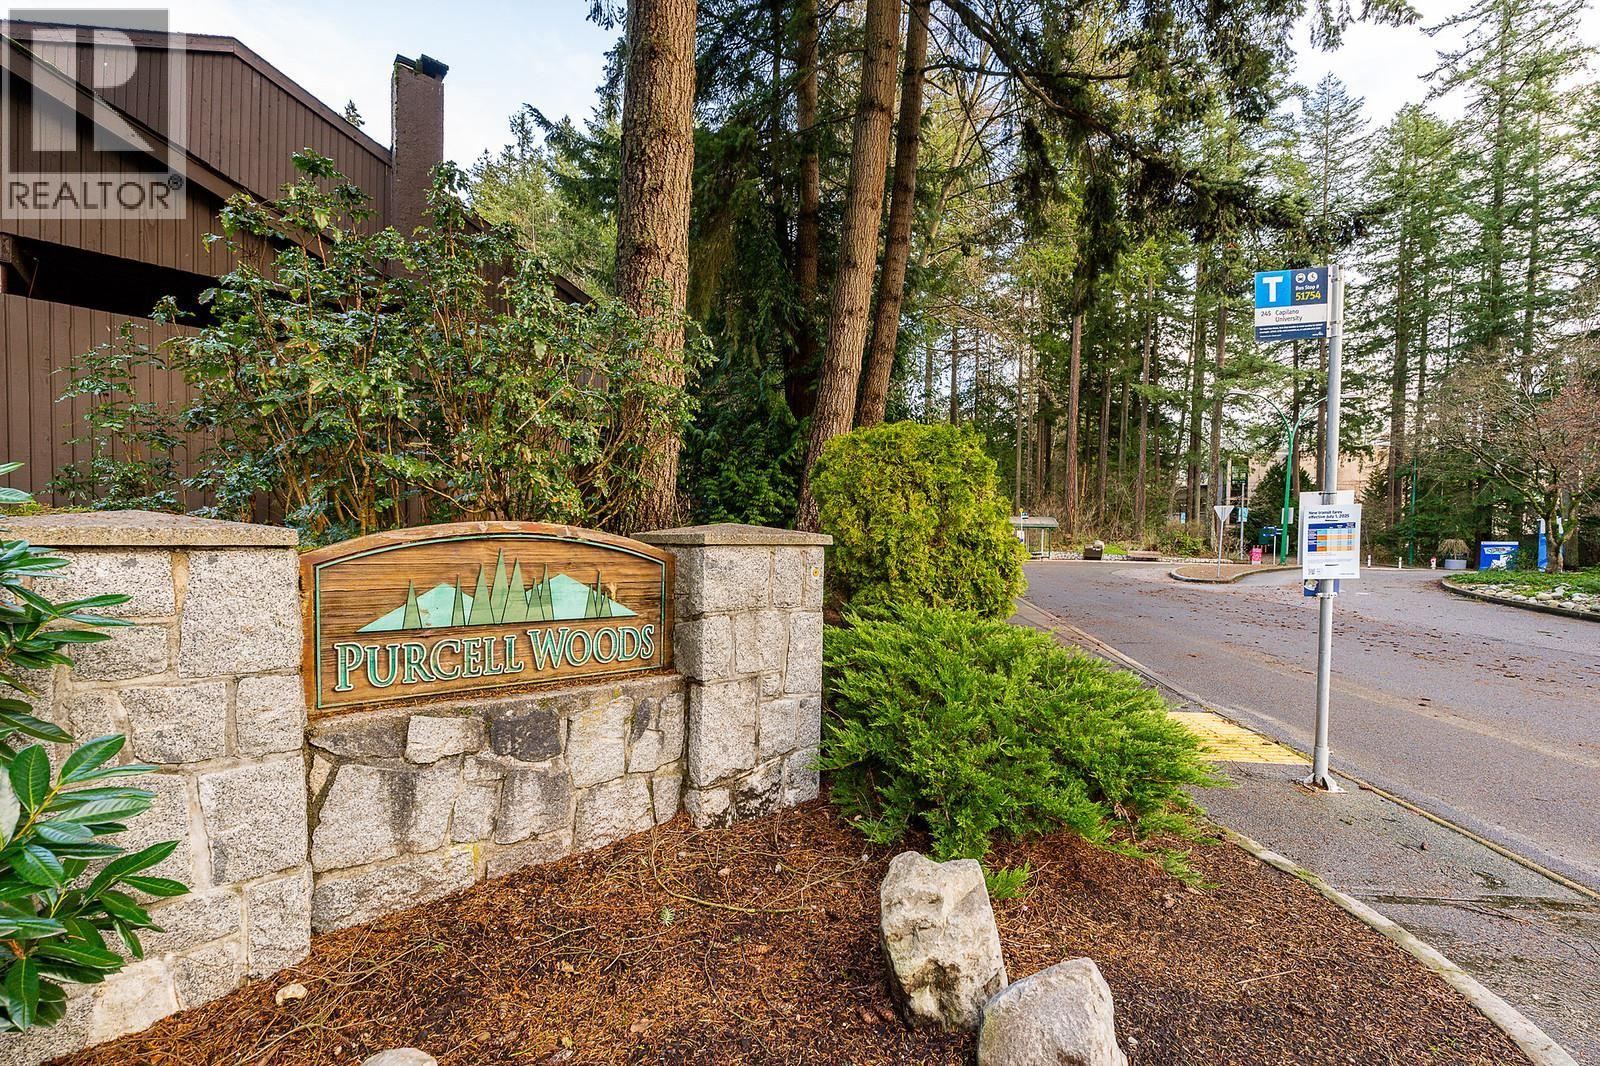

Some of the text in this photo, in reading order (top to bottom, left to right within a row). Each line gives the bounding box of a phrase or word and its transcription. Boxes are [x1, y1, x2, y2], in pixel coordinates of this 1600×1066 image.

[1262, 276, 1283, 302] T
[1295, 291, 1321, 301] 51754
[334, 624, 656, 692] PURCELL WOODS
